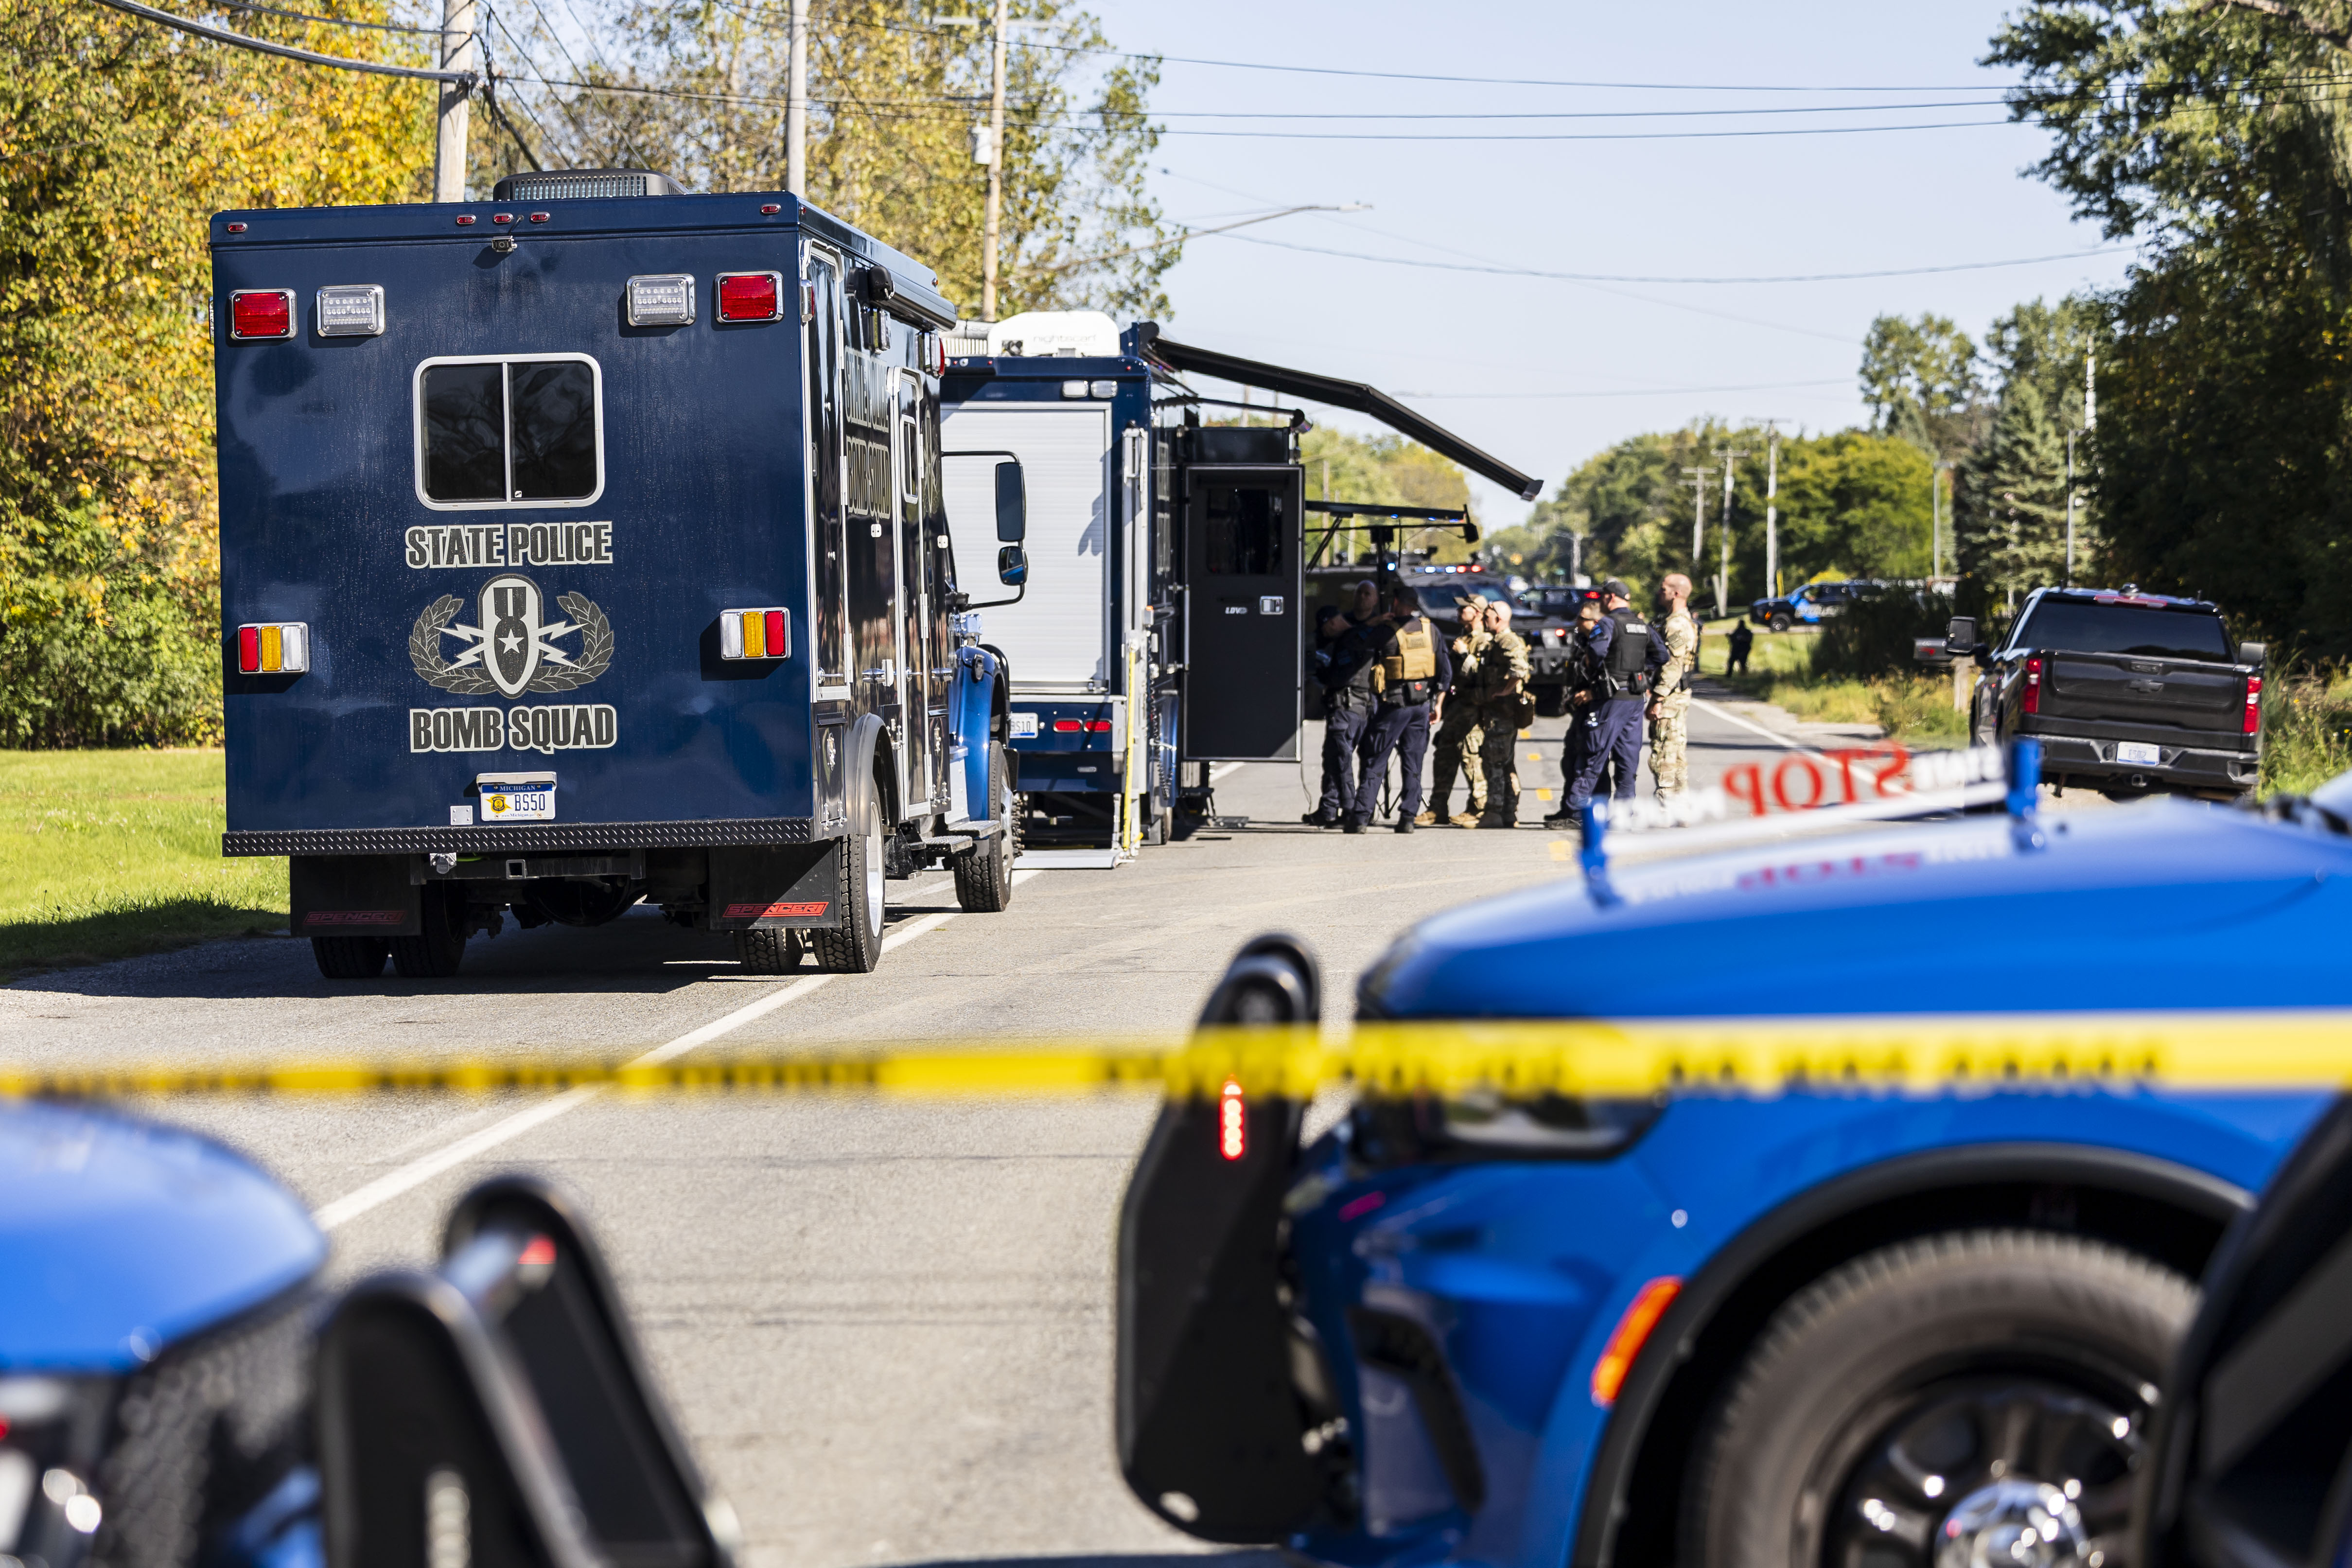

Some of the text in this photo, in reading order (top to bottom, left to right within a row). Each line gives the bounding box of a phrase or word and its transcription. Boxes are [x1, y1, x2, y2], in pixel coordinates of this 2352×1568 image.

[846, 435, 891, 524] BOMB SQUAD
[406, 521, 613, 568] STATE POLICE
[410, 705, 617, 754] BOMB SQUAD
[514, 794, 545, 811] BS50
